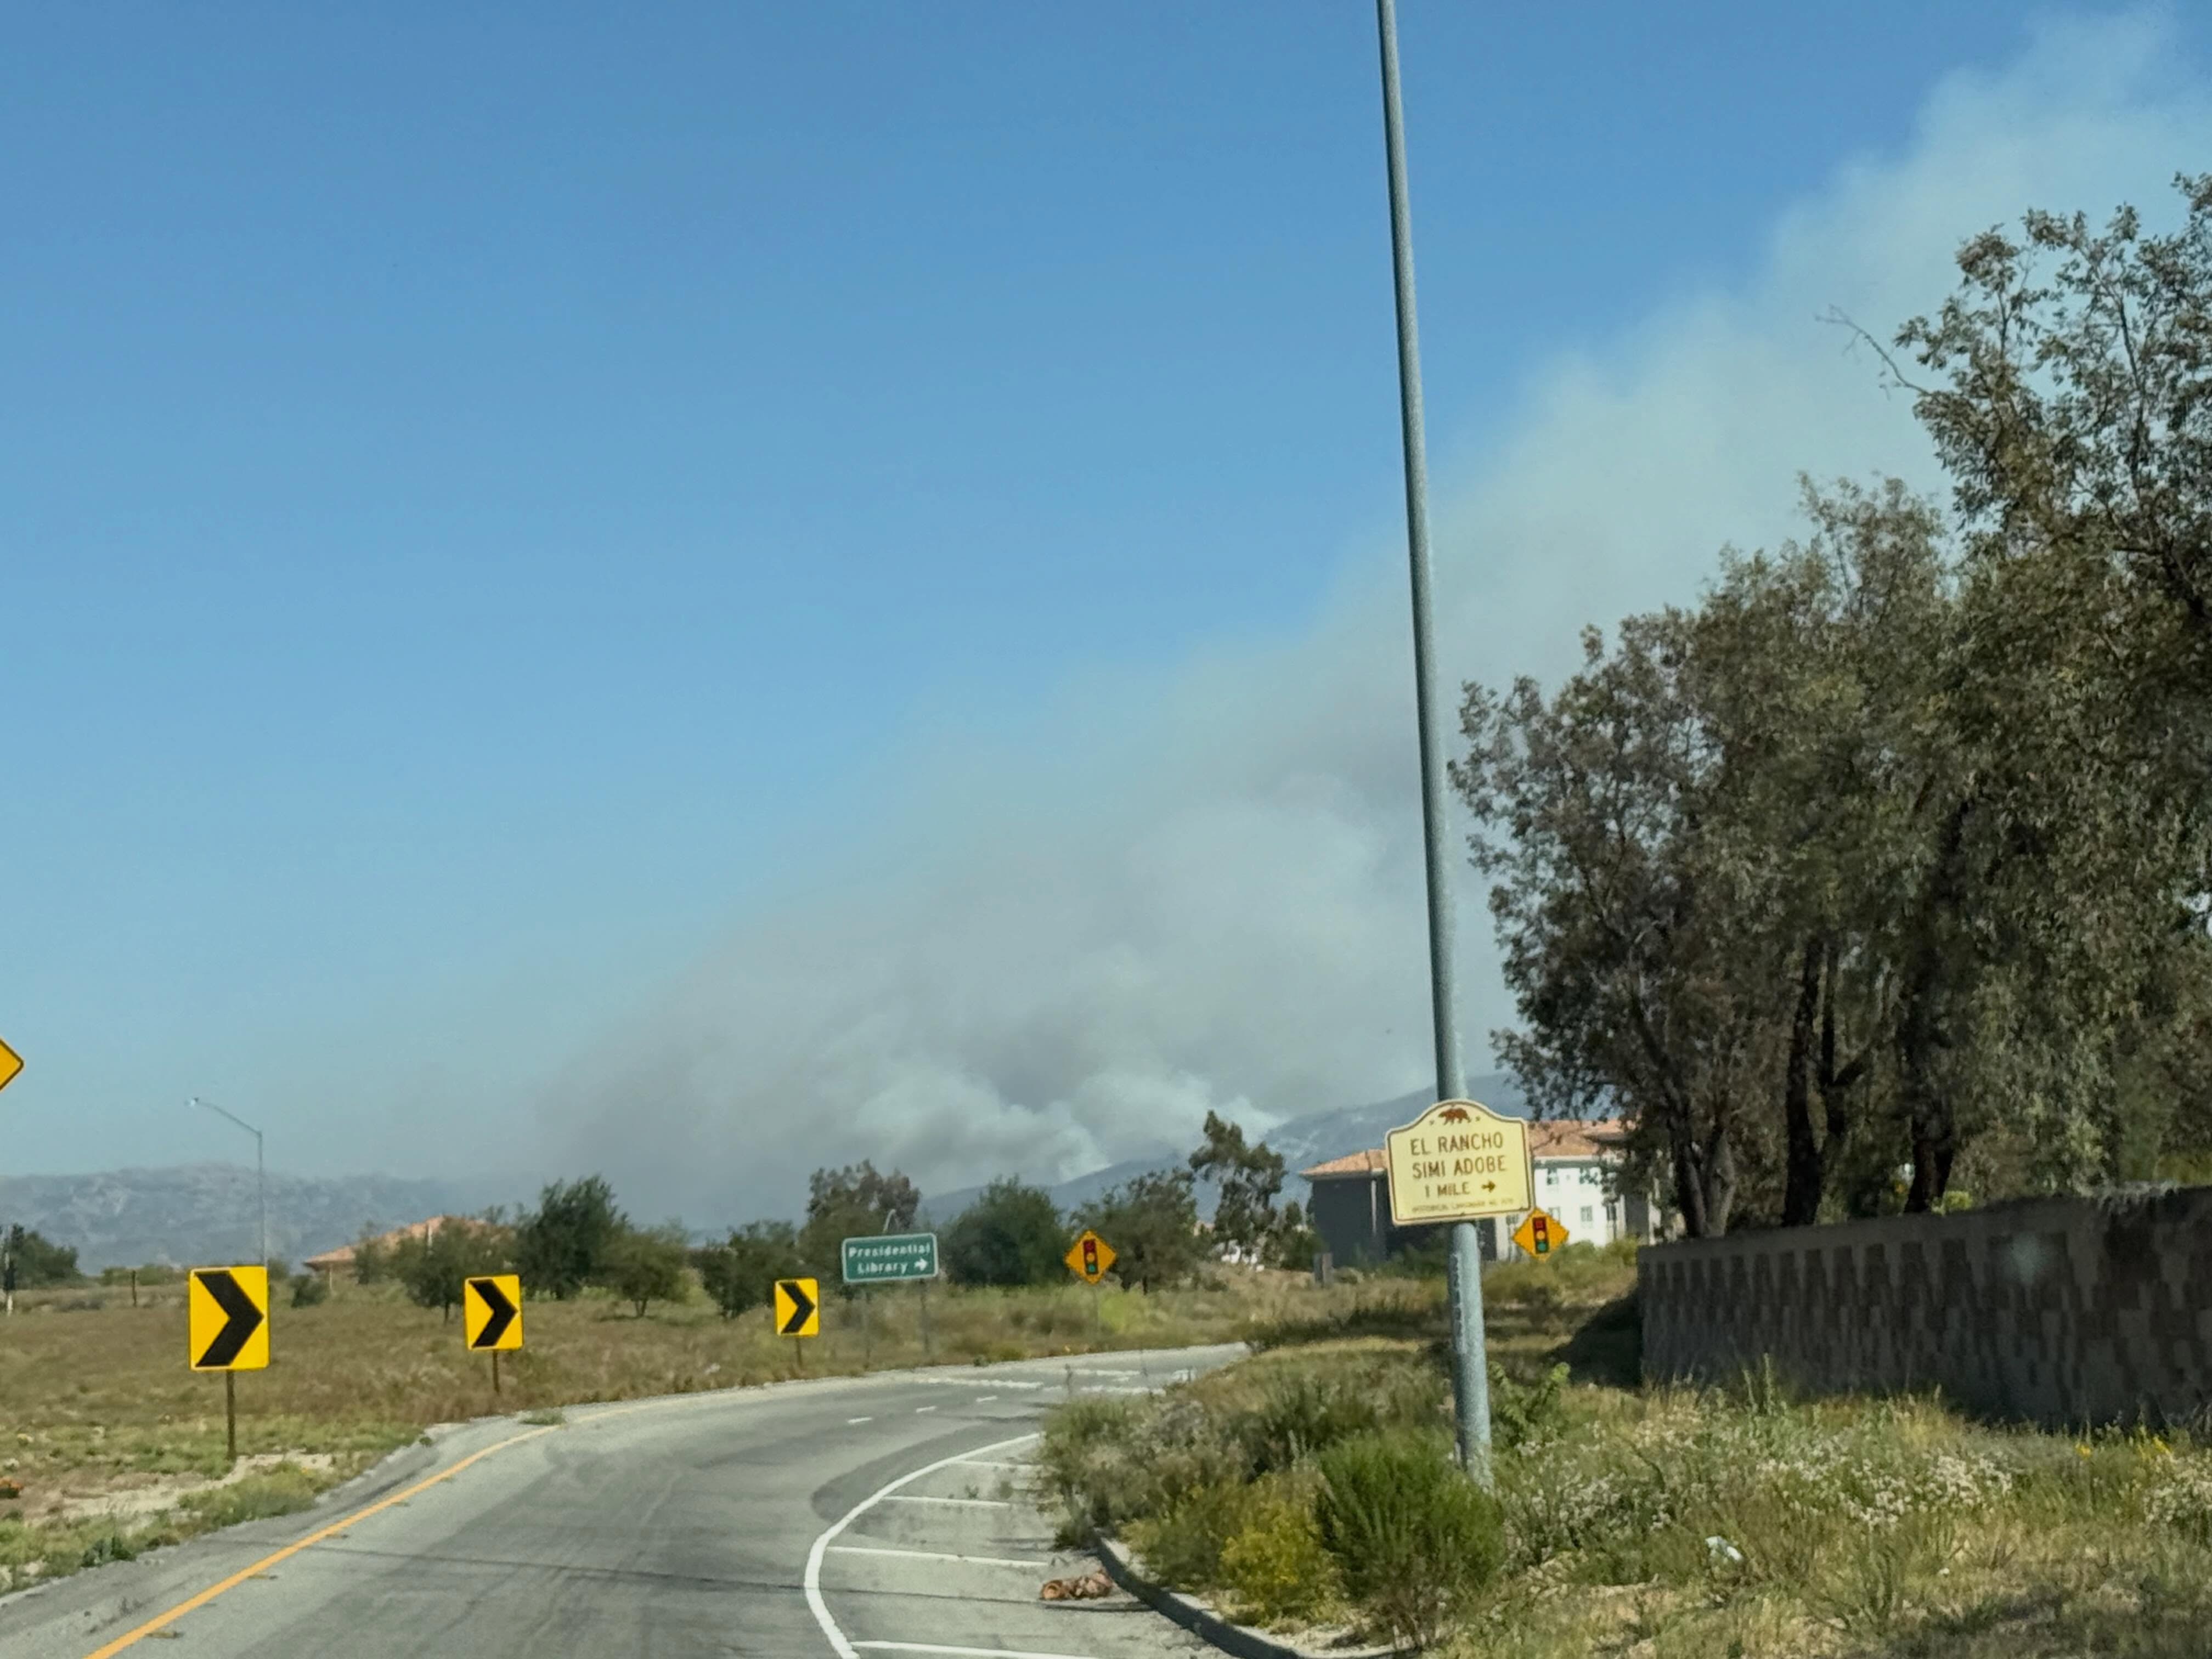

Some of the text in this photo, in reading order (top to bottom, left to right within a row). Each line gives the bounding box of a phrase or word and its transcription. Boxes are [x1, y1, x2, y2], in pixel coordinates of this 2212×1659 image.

[1410, 1132, 1504, 1155] EL RANCHO
[1412, 1155, 1508, 1180] SIMI ADOBE
[1425, 1182, 1471, 1198] 1 MILE
[848, 1242, 931, 1257] Presidential
[857, 1262, 908, 1274] Library
